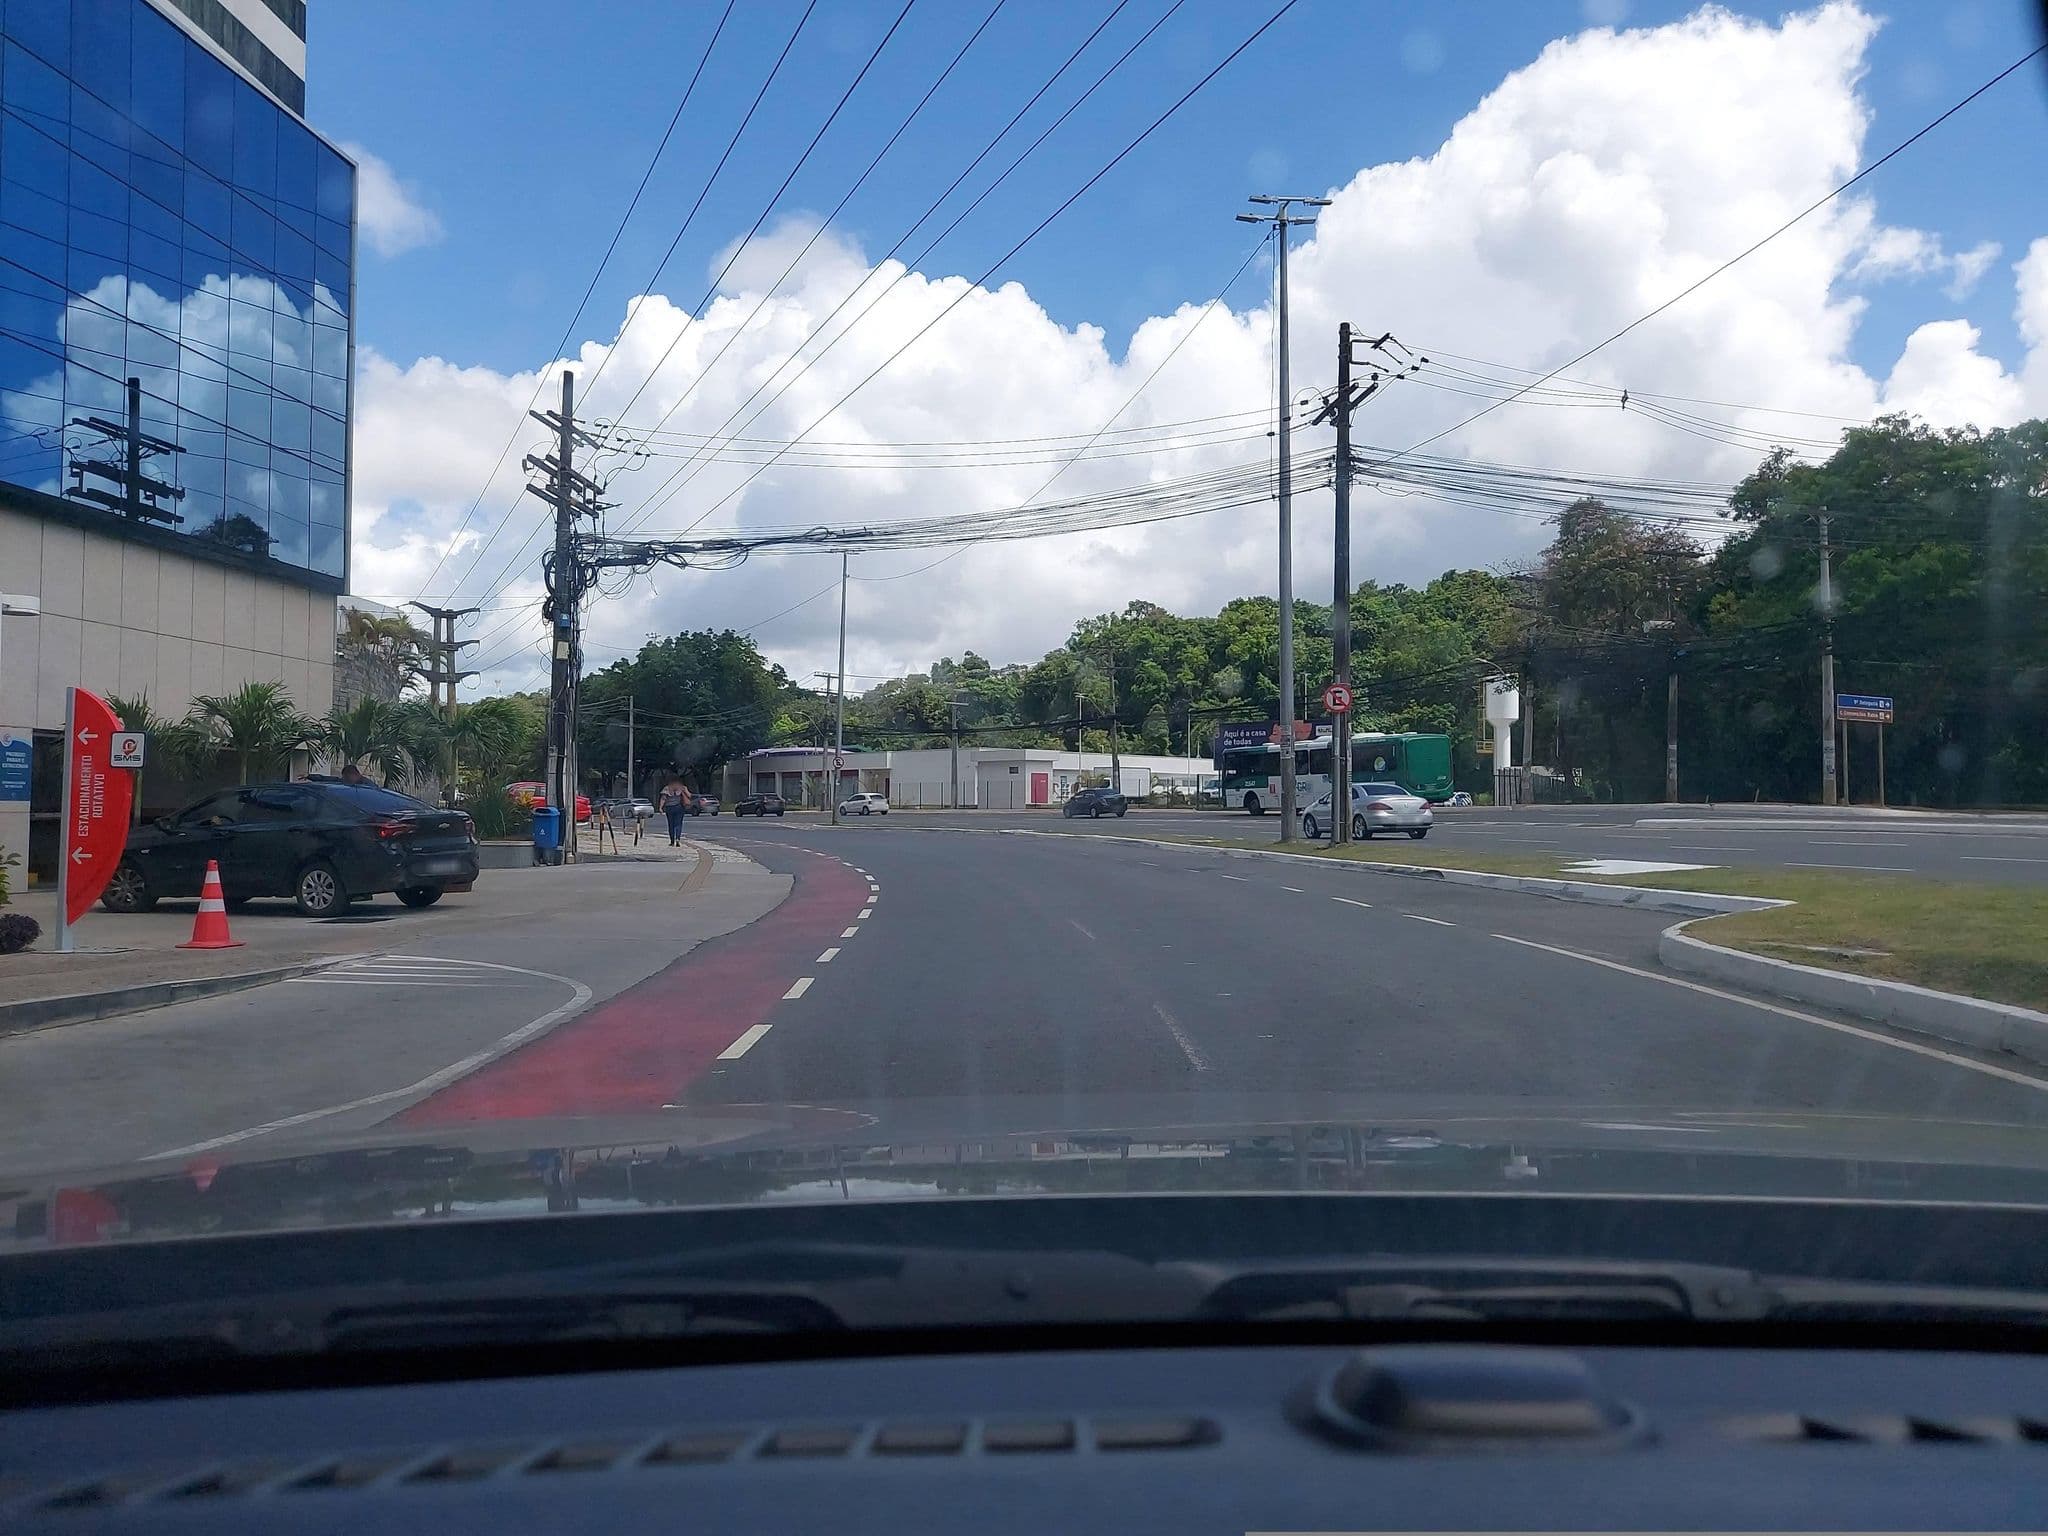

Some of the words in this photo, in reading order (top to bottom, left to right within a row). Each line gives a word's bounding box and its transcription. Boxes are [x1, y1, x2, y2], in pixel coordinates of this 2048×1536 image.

[1224, 730, 1239, 739] Aqui
[78, 755, 92, 837] ESTACIONAMENTO
[93, 773, 105, 818] ROTATIVO
